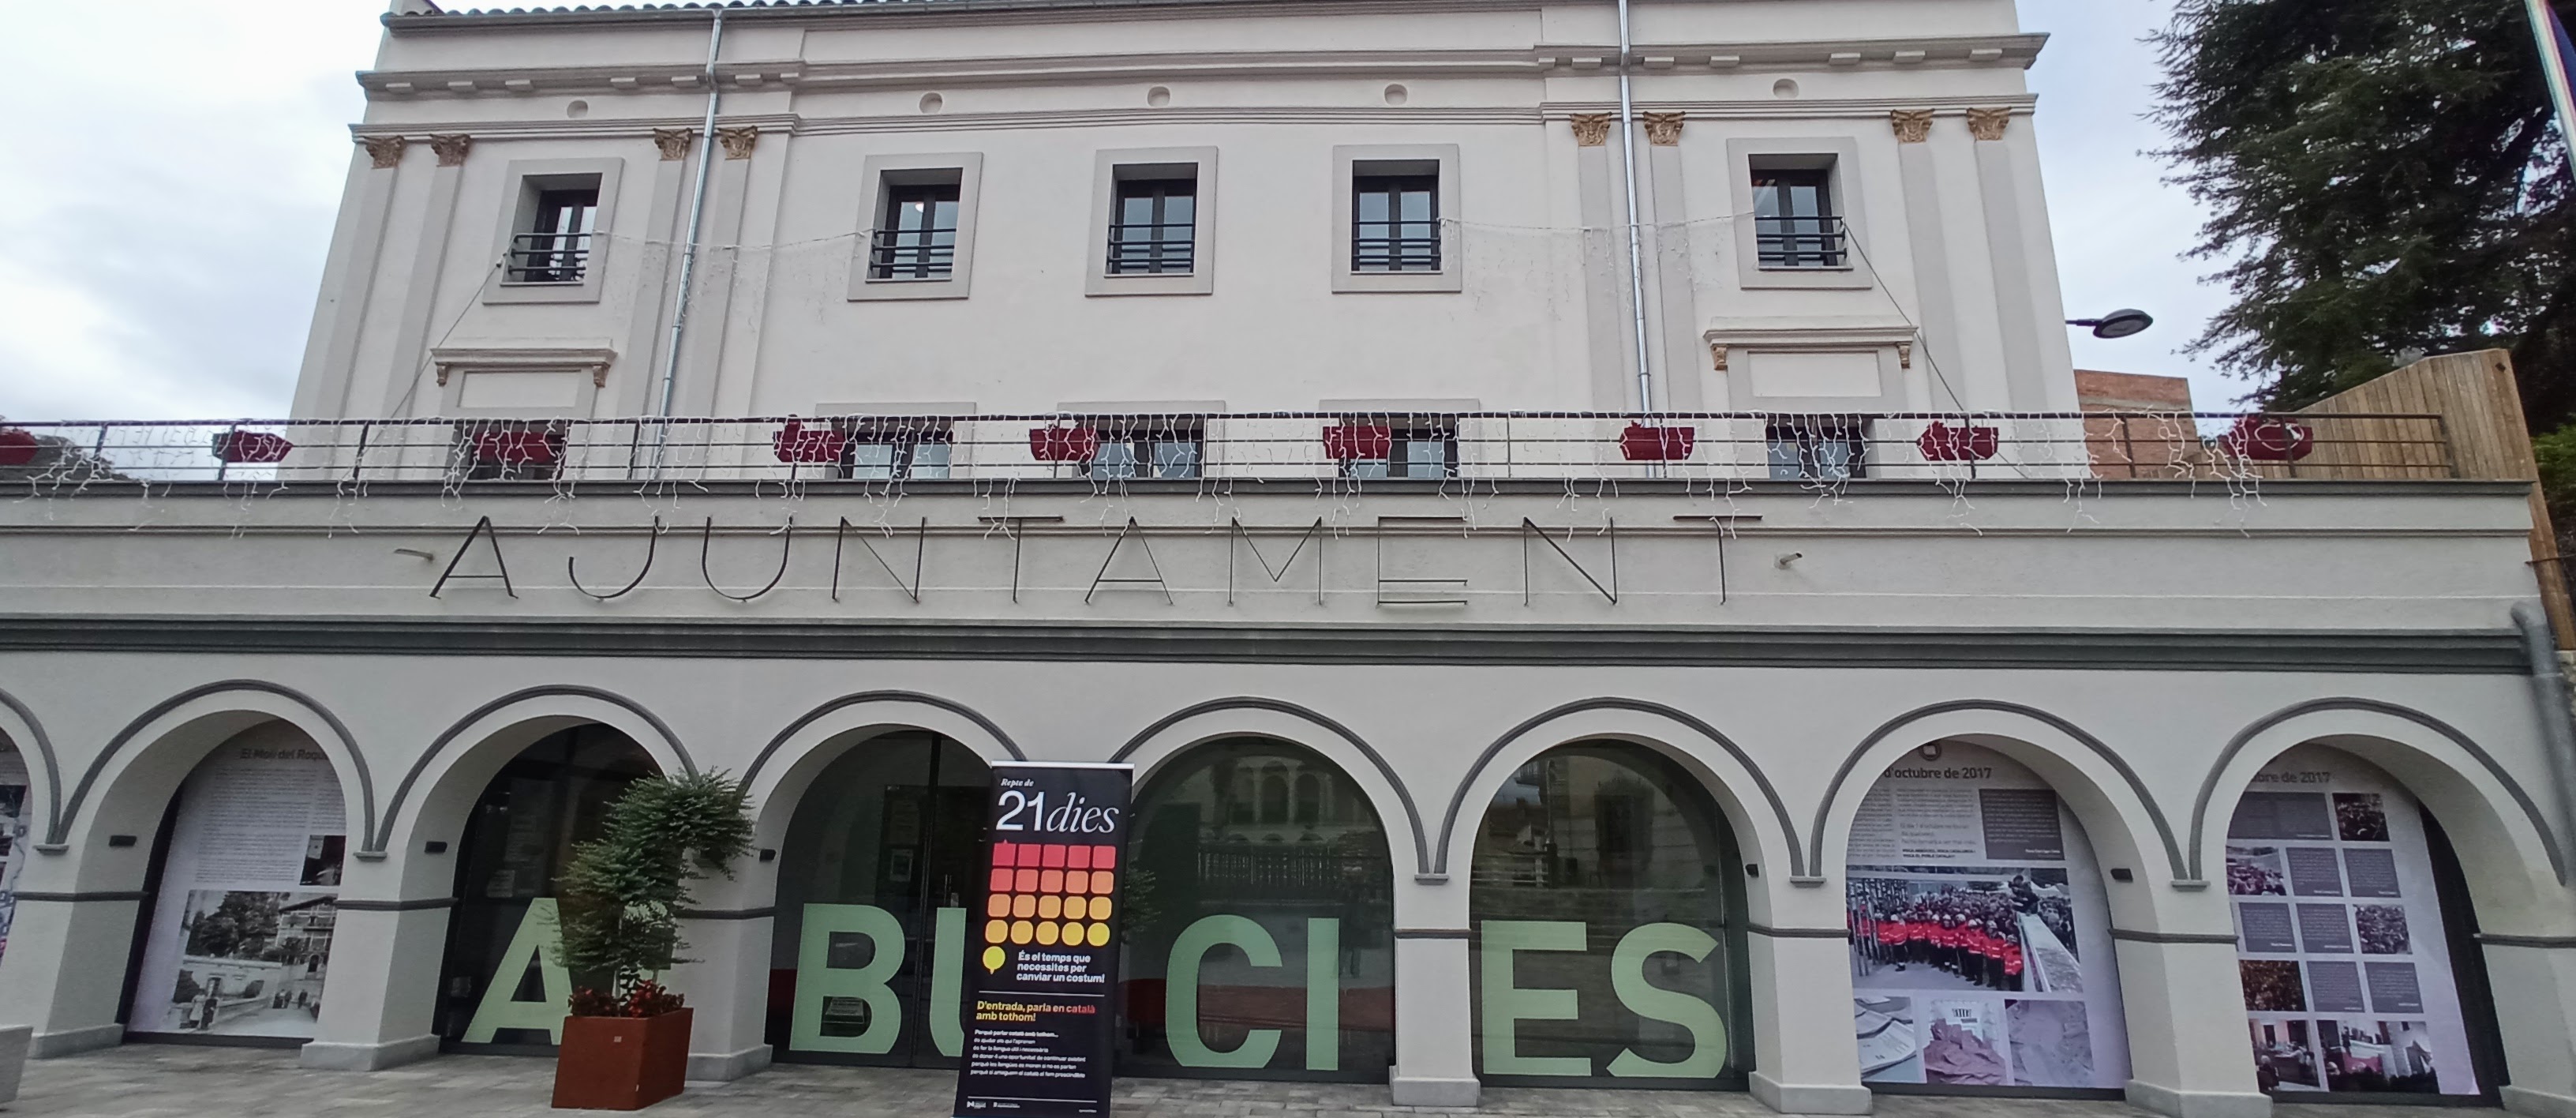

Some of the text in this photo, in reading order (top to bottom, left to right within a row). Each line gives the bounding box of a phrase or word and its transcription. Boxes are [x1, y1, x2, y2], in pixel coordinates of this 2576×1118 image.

[429, 514, 1763, 605] AJUNTAMENT
[1883, 767, 1992, 778] d'octubre de 2017
[2300, 771, 2331, 783] 2017
[1001, 778, 1035, 788] Repte de
[1018, 950, 1091, 965] És el temps que
[1017, 962, 1088, 974] necessites per
[1016, 973, 1052, 981] canviar
[1066, 974, 1105, 984] costum!
[976, 1000, 1026, 1013] D'entrada,
[1027, 1003, 1052, 1013] parla
[1065, 1004, 1096, 1014] català
[975, 1011, 1036, 1022] amb tothom!
